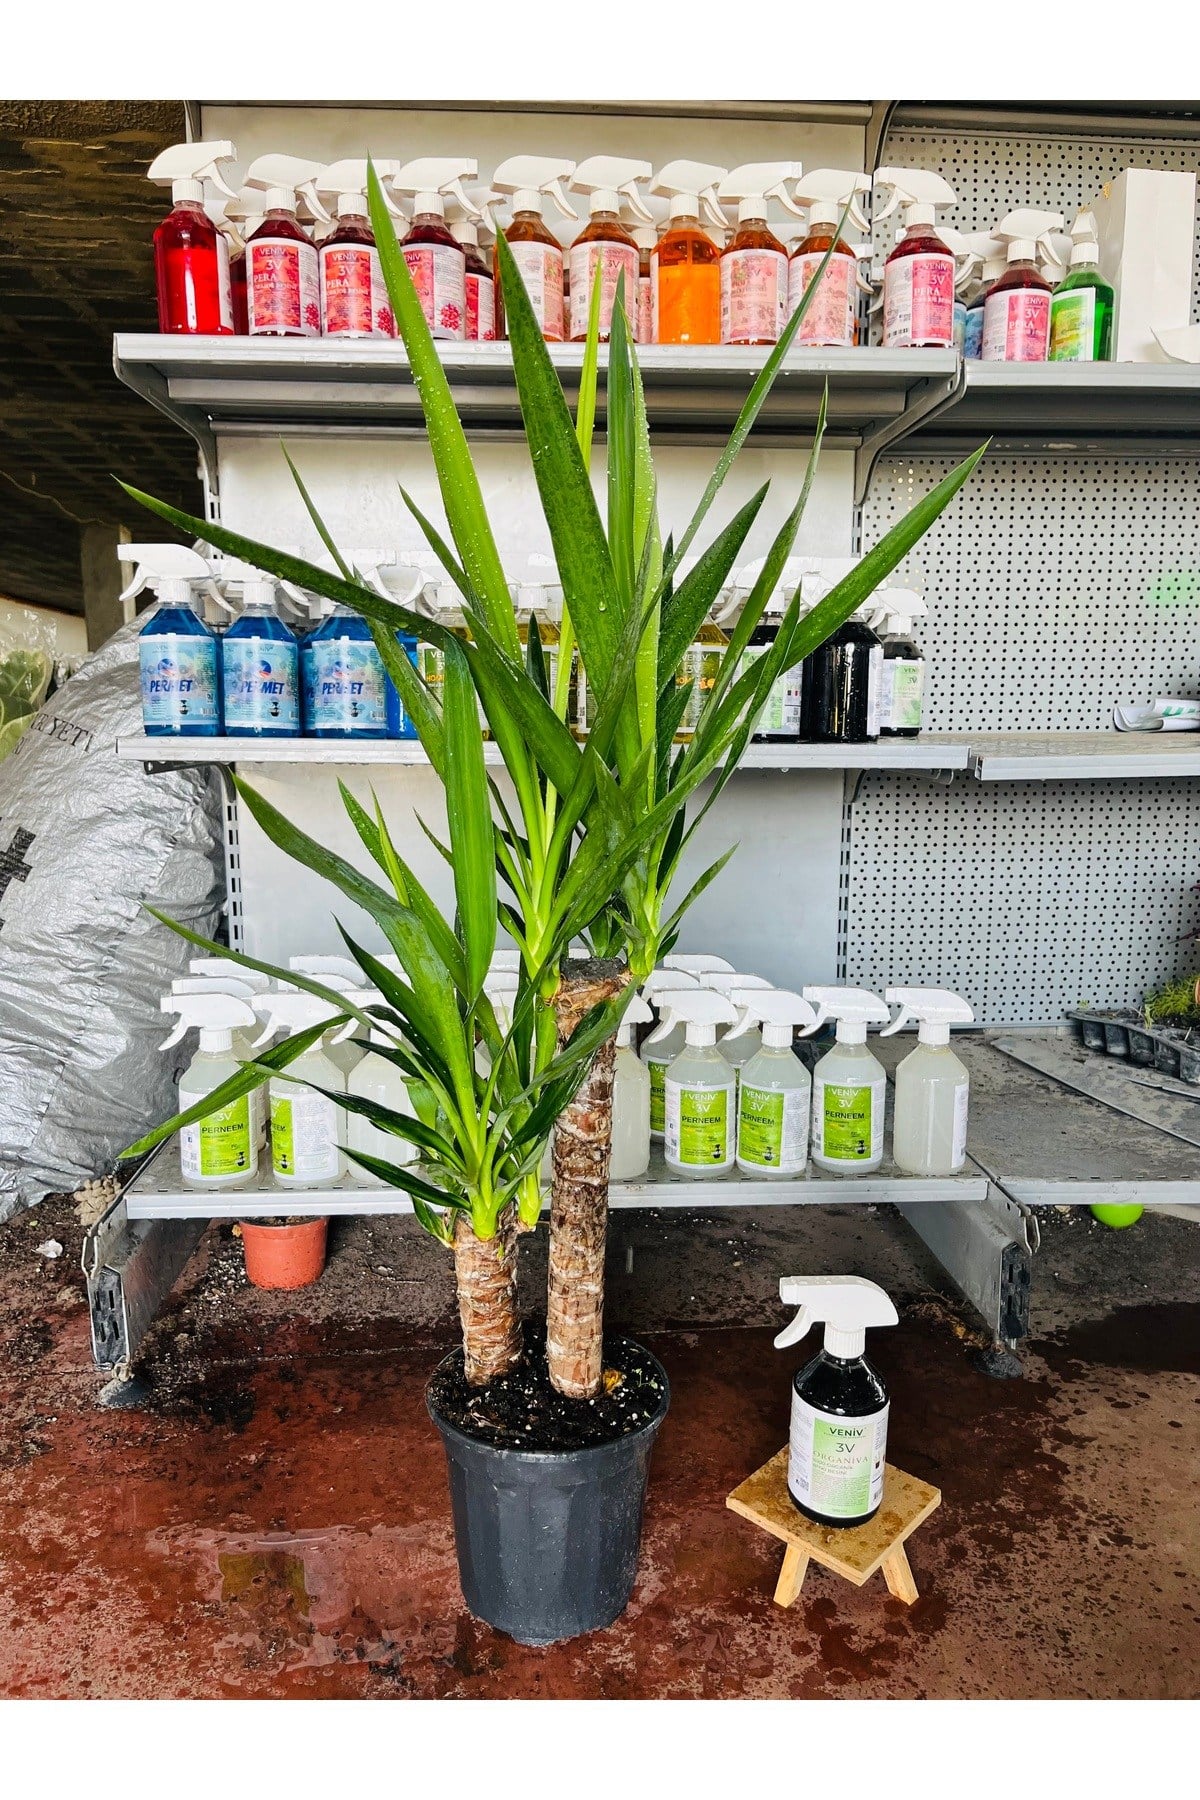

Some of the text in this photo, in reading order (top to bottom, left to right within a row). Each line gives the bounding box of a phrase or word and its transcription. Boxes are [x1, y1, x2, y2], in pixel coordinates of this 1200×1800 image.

[265, 259, 283, 271] 3V
[338, 265, 355, 276] 3V
[254, 273, 277, 282] PERA
[929, 274, 946, 286] 3V
[327, 279, 350, 288] PERA
[1025, 308, 1040, 319] 3V
[696, 1103, 711, 1113] 3V
[750, 1101, 764, 1112] 3V
[838, 1099, 854, 1108] 3V
[682, 1115, 721, 1124] PERNEEM
[741, 1110, 775, 1126] PERNEEM
[825, 1109, 865, 1119] PERNEEM
[201, 1123, 244, 1134] PERNEEM
[829, 1427, 863, 1437] VENİV
[835, 1442, 856, 1453] 3V
